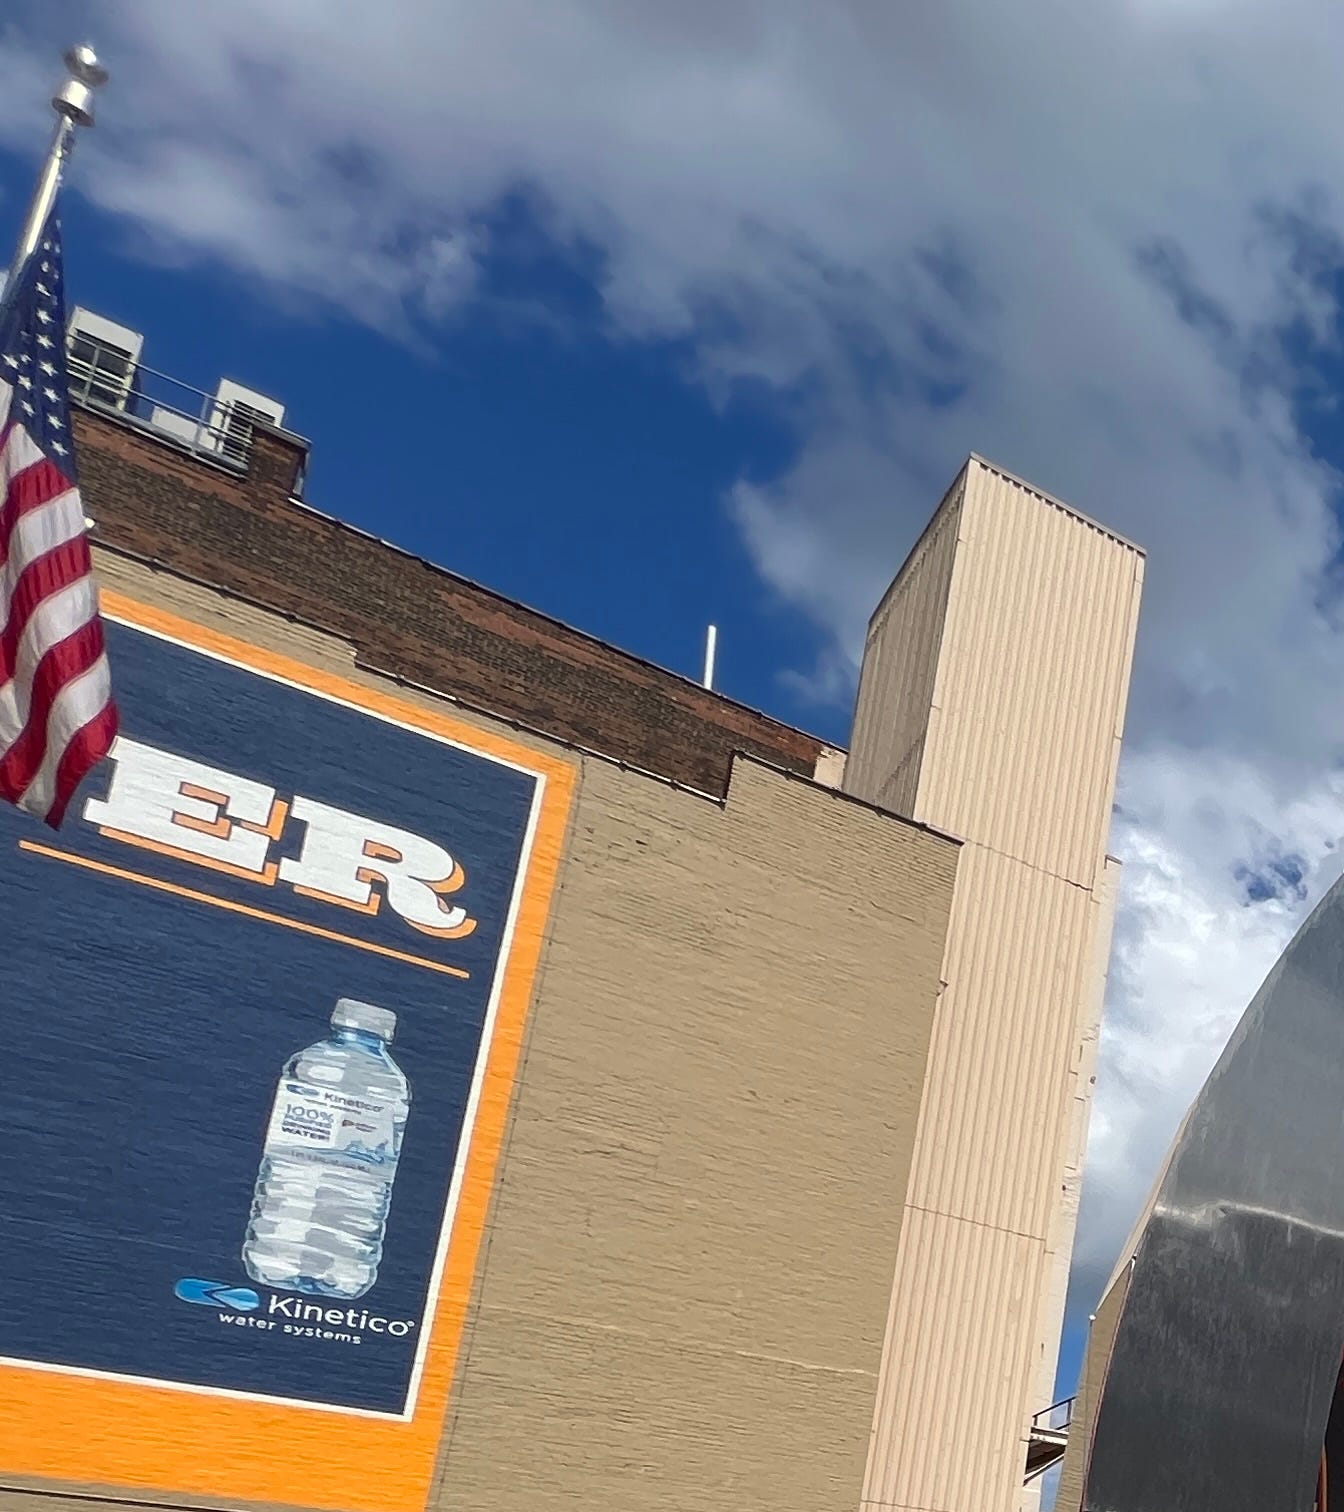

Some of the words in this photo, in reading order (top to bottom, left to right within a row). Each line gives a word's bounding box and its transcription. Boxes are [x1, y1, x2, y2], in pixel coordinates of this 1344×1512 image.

[286, 1103, 335, 1124] 100%
[219, 1312, 277, 1331] water
[283, 1323, 362, 1346] systems
